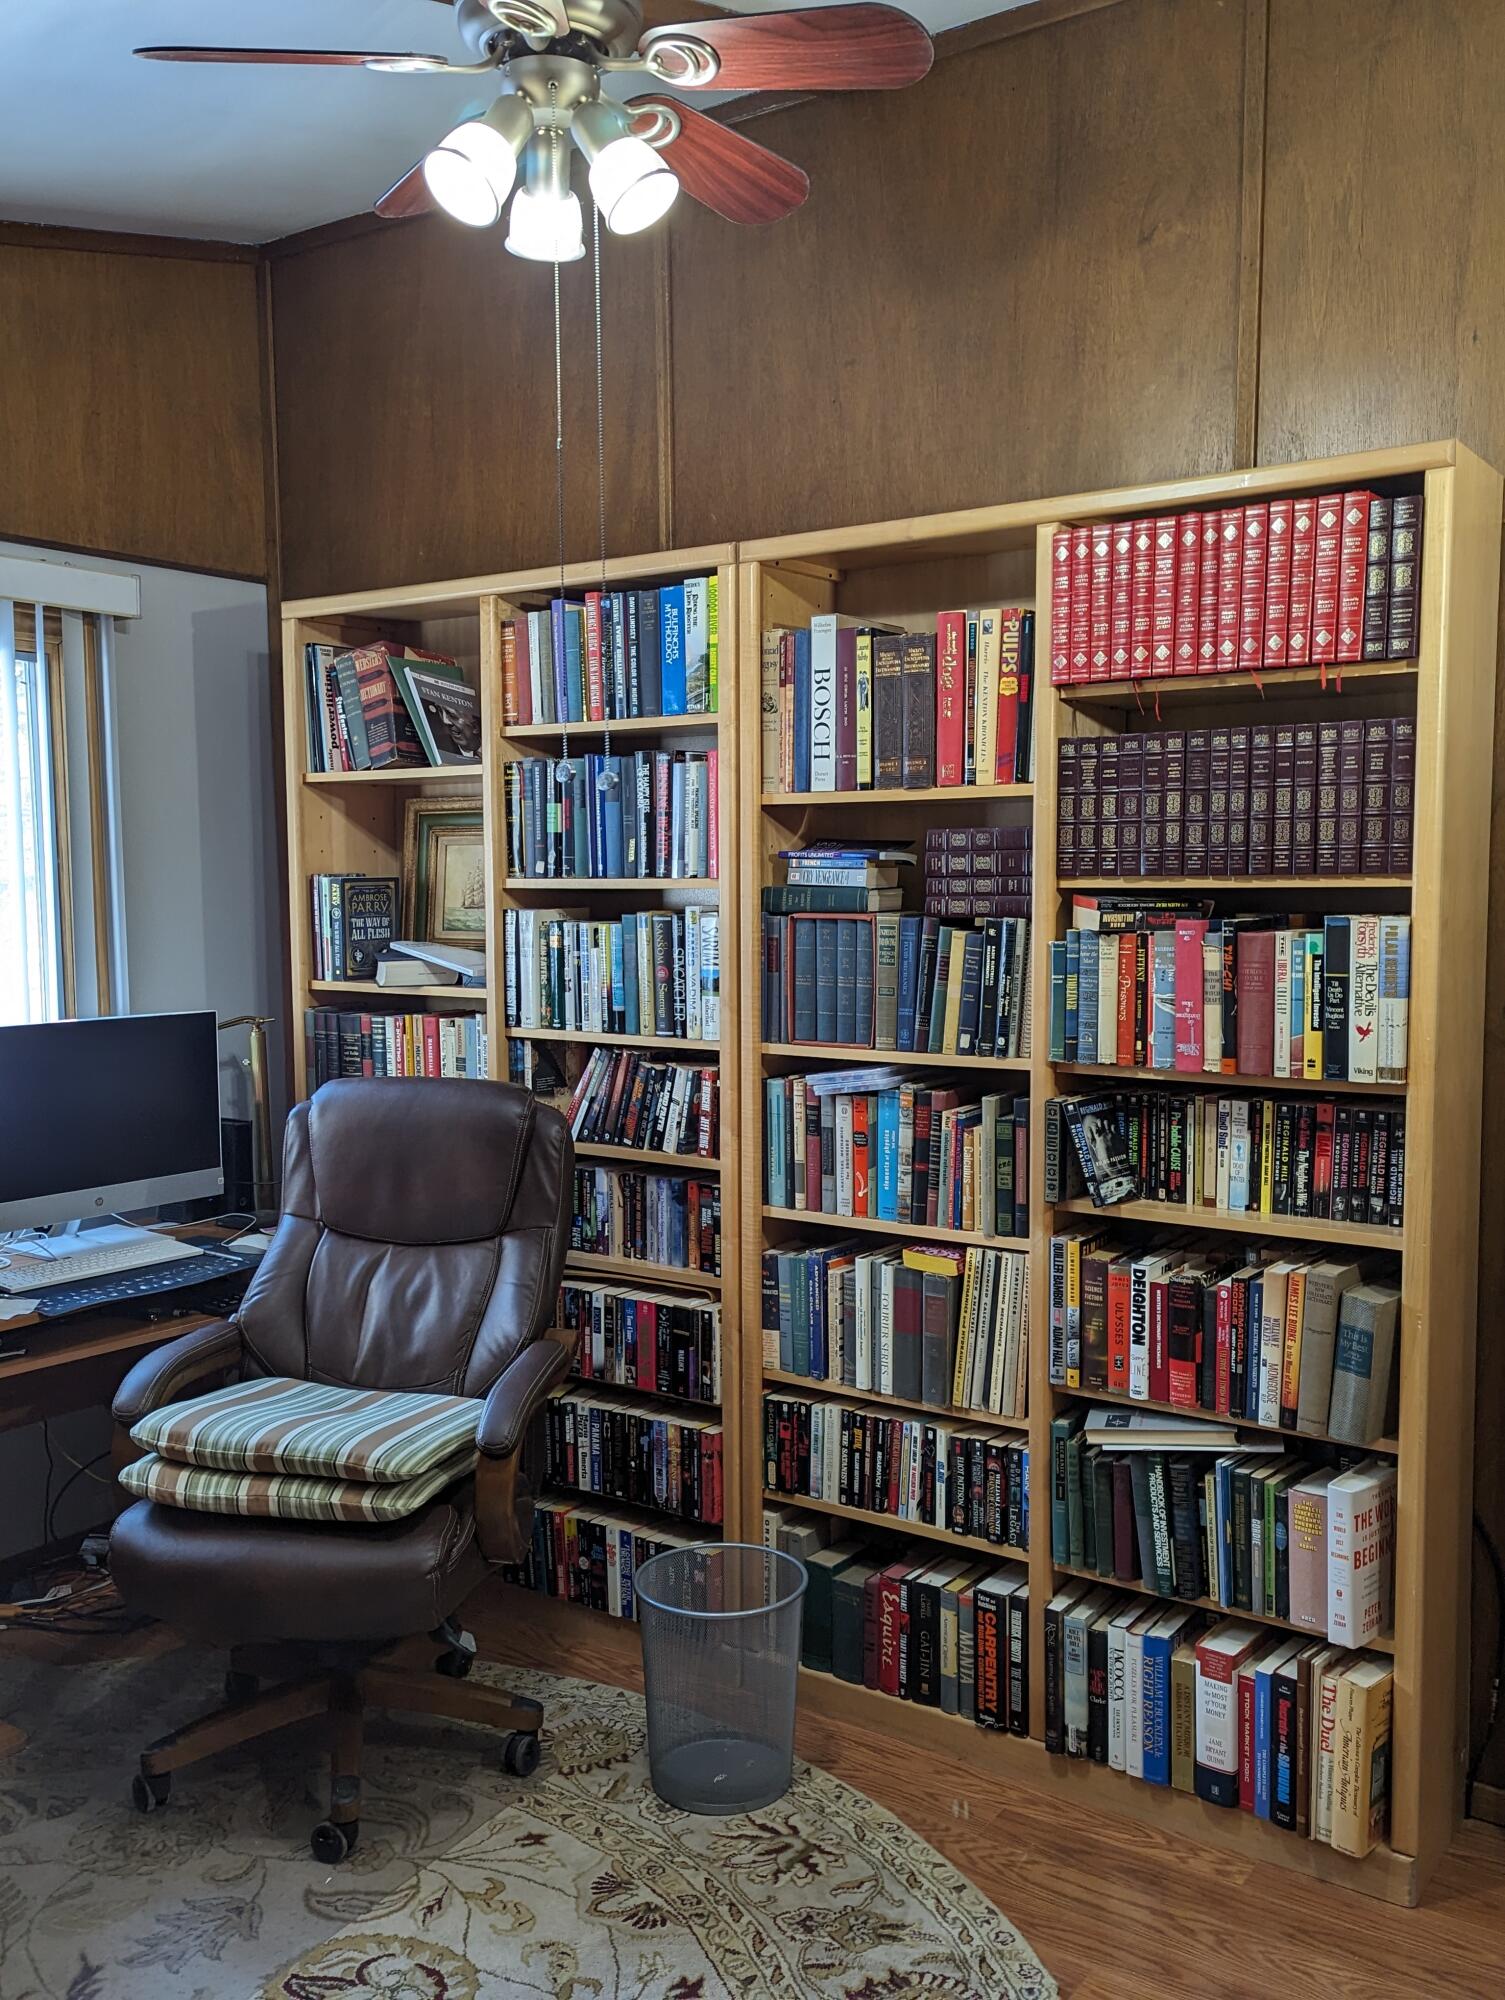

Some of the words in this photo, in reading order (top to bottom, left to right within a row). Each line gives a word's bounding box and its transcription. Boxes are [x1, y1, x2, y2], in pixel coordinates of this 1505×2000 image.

[709, 584, 718, 612] VOODOO
[587, 599, 598, 630] LAWRENCE
[709, 614, 718, 635] RIVER
[589, 633, 599, 650] BLOCK
[1001, 621, 1018, 673] PULPS
[590, 656, 599, 671] EVEN
[590, 672, 599, 681] THE
[325, 666, 339, 749] powerlifting
[335, 696, 346, 712] Stan
[421, 687, 439, 699] STAN
[441, 691, 473, 708] KENTON
[591, 681, 600, 706] WICKED
[338, 712, 348, 740] Kenton
[814, 668, 831, 761] BOSCH
[980, 719, 988, 764] KRONICLES
[637, 768, 643, 778] OF
[351, 901, 389, 913] PARRY
[352, 894, 387, 902] AMBROSE
[351, 918, 364, 928] THE
[366, 917, 380, 928] WAY
[381, 917, 390, 927] OF
[351, 930, 366, 941] ALL
[368, 928, 390, 940] FLESH
[655, 923, 663, 964] SANSOM
[702, 926, 719, 967] SARUM
[1357, 921, 1368, 959] Forsyth
[1368, 922, 1378, 958] Frederick
[540, 939, 548, 985] MAN-EATERS
[1313, 960, 1321, 970] The
[1365, 962, 1377, 985] The
[672, 947, 686, 1021] SPYCATCHER
[689, 973, 697, 1010] VADIM
[1312, 971, 1321, 1002] Intelligent
[1354, 962, 1366, 1016] Alternative
[1312, 1003, 1320, 1028] Investor
[1364, 986, 1377, 1017] Devil's
[661, 1081, 672, 1106] BLIND
[701, 1087, 711, 1112] DESCENT
[656, 1107, 668, 1132] FAITH
[666, 1104, 677, 1138] DECEMBER
[700, 1116, 710, 1131] JEFF
[1171, 1112, 1182, 1147] Probable
[700, 1132, 709, 1148] LONG
[1076, 1123, 1093, 1160] REGINALD
[1086, 1161, 1094, 1177] HILL
[1282, 1119, 1290, 1162] REGINALD
[1341, 1133, 1350, 1172] REGINALD
[1359, 1132, 1367, 1172] REGINALD
[1377, 1131, 1387, 1175] REGINALD
[962, 1146, 974, 1184] Calculus
[1171, 1147, 1181, 1170] CAUSE
[1297, 1150, 1310, 1162] Thy
[1281, 1165, 1289, 1182] HILL
[1296, 1162, 1308, 1191] Neighbor's
[1340, 1173, 1348, 1188] HILL
[1358, 1173, 1366, 1188] HILL
[1376, 1177, 1385, 1194] HILL
[1296, 1192, 1307, 1206] Wife
[1053, 1243, 1064, 1273] QUILLER
[984, 1258, 992, 1298] ADVANCED
[1001, 1257, 1009, 1305] ENGINEERING
[1012, 1266, 1020, 1316] STATISTICS
[1053, 1274, 1064, 1308] BAMBOO
[1288, 1276, 1301, 1303] JAMES
[962, 1274, 971, 1314] MECHANICS
[1132, 1268, 1145, 1346] DEIGHTON
[626, 1315, 634, 1326] Tom
[881, 1293, 893, 1340] FOURIER
[980, 1302, 988, 1339] CALCULUS
[1115, 1302, 1124, 1345] ULYSSES
[1237, 1282, 1245, 1361] MATHEMATICAL
[1288, 1305, 1298, 1317] LEE
[626, 1327, 634, 1343] Clancy
[997, 1307, 1005, 1347] MECHANICS
[1052, 1325, 1063, 1348] ADAM
[1287, 1318, 1297, 1343] BURKE
[881, 1342, 890, 1376] SERIES
[956, 1330, 966, 1374] HYDRAULICS
[1052, 1350, 1063, 1368] HALL
[1266, 1363, 1279, 1404] MONGOOSE
[592, 1422, 600, 1455] PANAMA
[841, 1430, 849, 1447] THE
[841, 1448, 849, 1485] SATANIST
[956, 1456, 964, 1475] ELIOT
[1148, 1472, 1158, 1513] PRODUCTS
[1154, 1465, 1165, 1508] HANDBOOK
[1009, 1508, 1018, 1546] LEGACY
[1152, 1513, 1160, 1530] AND
[1158, 1509, 1166, 1520] OF
[1354, 1513, 1373, 1533] THE
[1160, 1520, 1170, 1568] INVESTMENT
[1251, 1518, 1262, 1546] GORDIE
[1154, 1530, 1164, 1567] SERVICES
[880, 1590, 900, 1670] Esquire
[1047, 1622, 1057, 1646] ROSE
[920, 1630, 931, 1677] GAI-JIN
[960, 1629, 974, 1684] MANTA
[984, 1612, 997, 1713] CARPENTRY
[1114, 1648, 1125, 1701] IACOCCA
[1144, 1656, 1154, 1698] RIGHT
[1204, 1680, 1228, 1693] MAKING
[1090, 1696, 1106, 1704] Clarke
[1210, 1701, 1227, 1711] YOUR
[1212, 1691, 1227, 1702] MOST
[1321, 1684, 1337, 1714] The
[1144, 1700, 1153, 1752] REASON
[1205, 1708, 1226, 1719] MONEY
[1320, 1714, 1335, 1753] Duel
